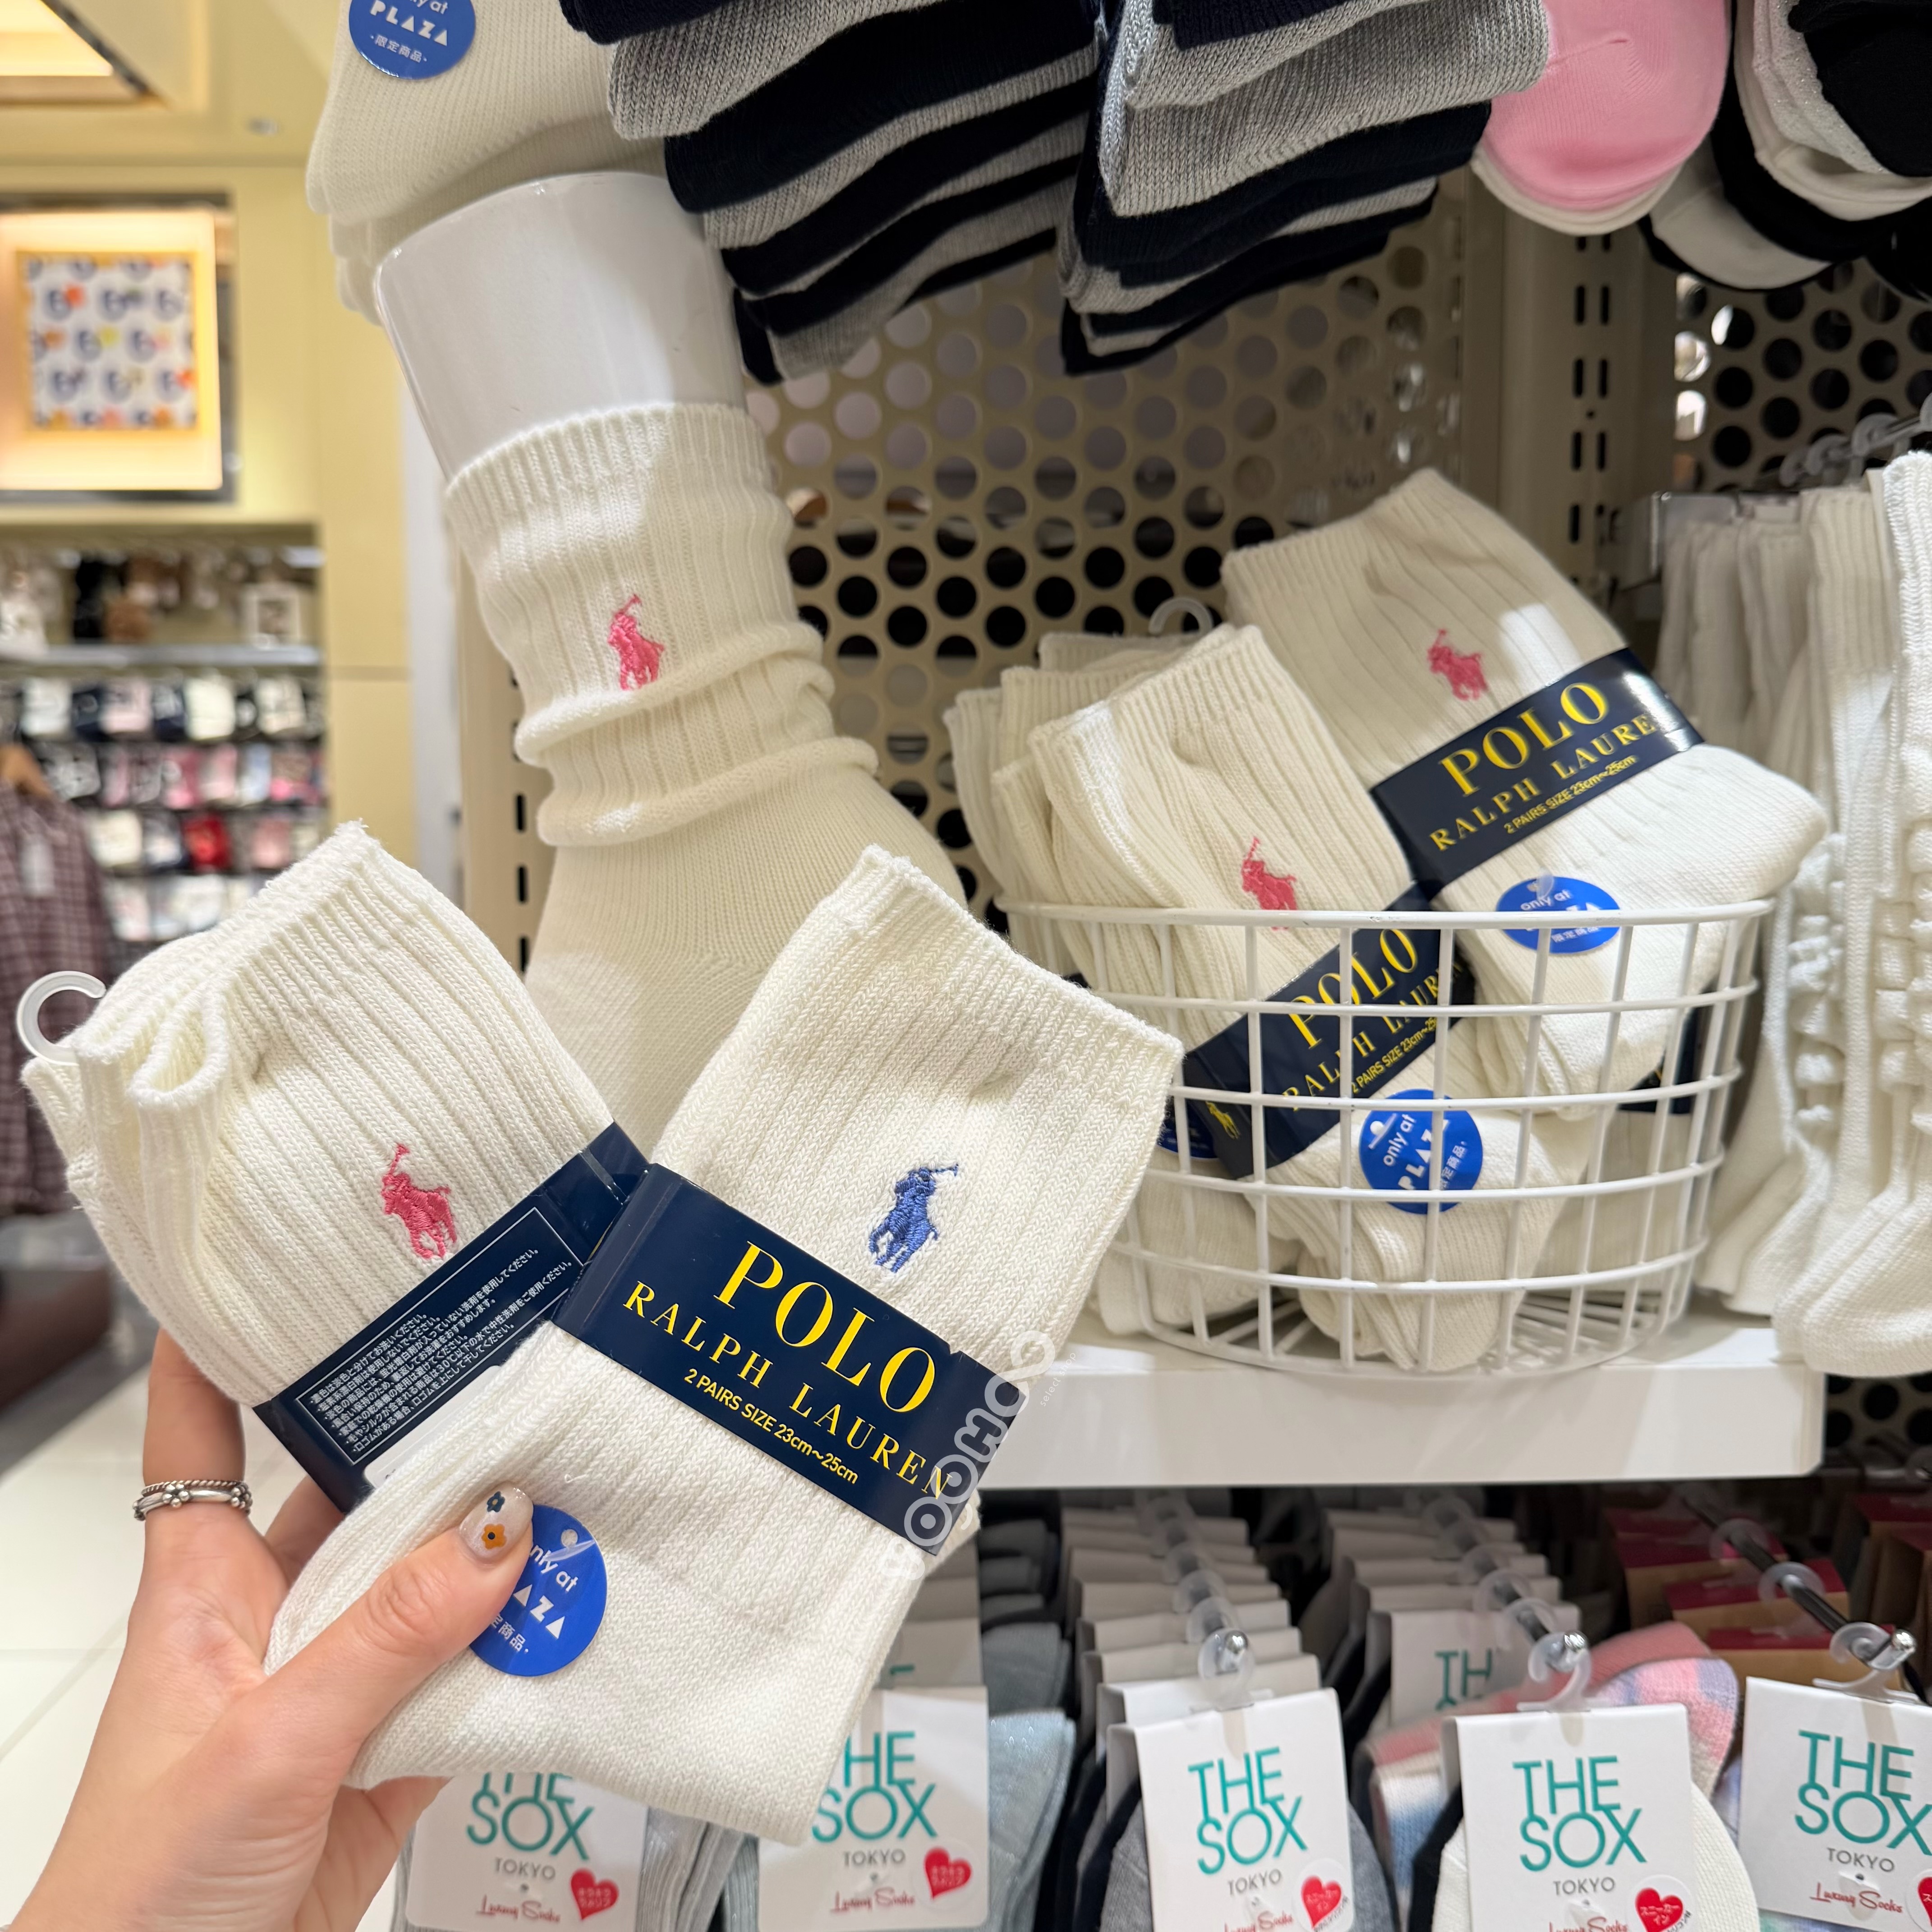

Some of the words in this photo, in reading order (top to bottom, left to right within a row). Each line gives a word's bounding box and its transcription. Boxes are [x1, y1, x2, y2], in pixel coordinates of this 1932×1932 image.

[369, 0, 448, 46] PLAZA
[1438, 682, 1609, 797] POLO
[1430, 778, 1541, 851] RALPH
[1550, 713, 1658, 780] LAURE
[1504, 822, 1514, 834] 2
[1512, 804, 1547, 829] PAIRS
[1546, 788, 1573, 809] SIZE
[1554, 889, 1573, 902] at
[1356, 1061, 1385, 1088] PAIRS
[1381, 1045, 1403, 1067] SIZE
[1383, 1132, 1408, 1167] only
[1400, 1113, 1417, 1133] at
[713, 1240, 936, 1413] POLO
[623, 1281, 774, 1389] RALPH
[789, 1382, 953, 1500] LAUREN
[684, 1368, 698, 1384] 2
[696, 1375, 743, 1411] PAIRS
[741, 1403, 777, 1432] SIZE
[529, 1545, 559, 1574] nly
[556, 1570, 579, 1592] at
[513, 1583, 566, 1640] AZA
[1435, 1648, 1492, 1701] TH
[843, 1731, 915, 1789] HE
[1187, 1746, 1285, 1821] THE
[1512, 1755, 1621, 1818] THE
[1798, 1729, 1915, 1801] THE
[466, 1789, 595, 1861] SOX
[812, 1783, 938, 1843] SOX
[1196, 1796, 1309, 1875] SOX
[1519, 1808, 1647, 1872] SOX
[1794, 1782, 1932, 1856] SOX
[495, 1857, 557, 1881] TOKYO
[844, 1848, 906, 1867] TOKYO
[1228, 1868, 1282, 1896] TOKYO
[1553, 1876, 1615, 1895] TOKYO
[1826, 1847, 1895, 1872] TOKYO
[1858, 1890, 1903, 1914] Socks
